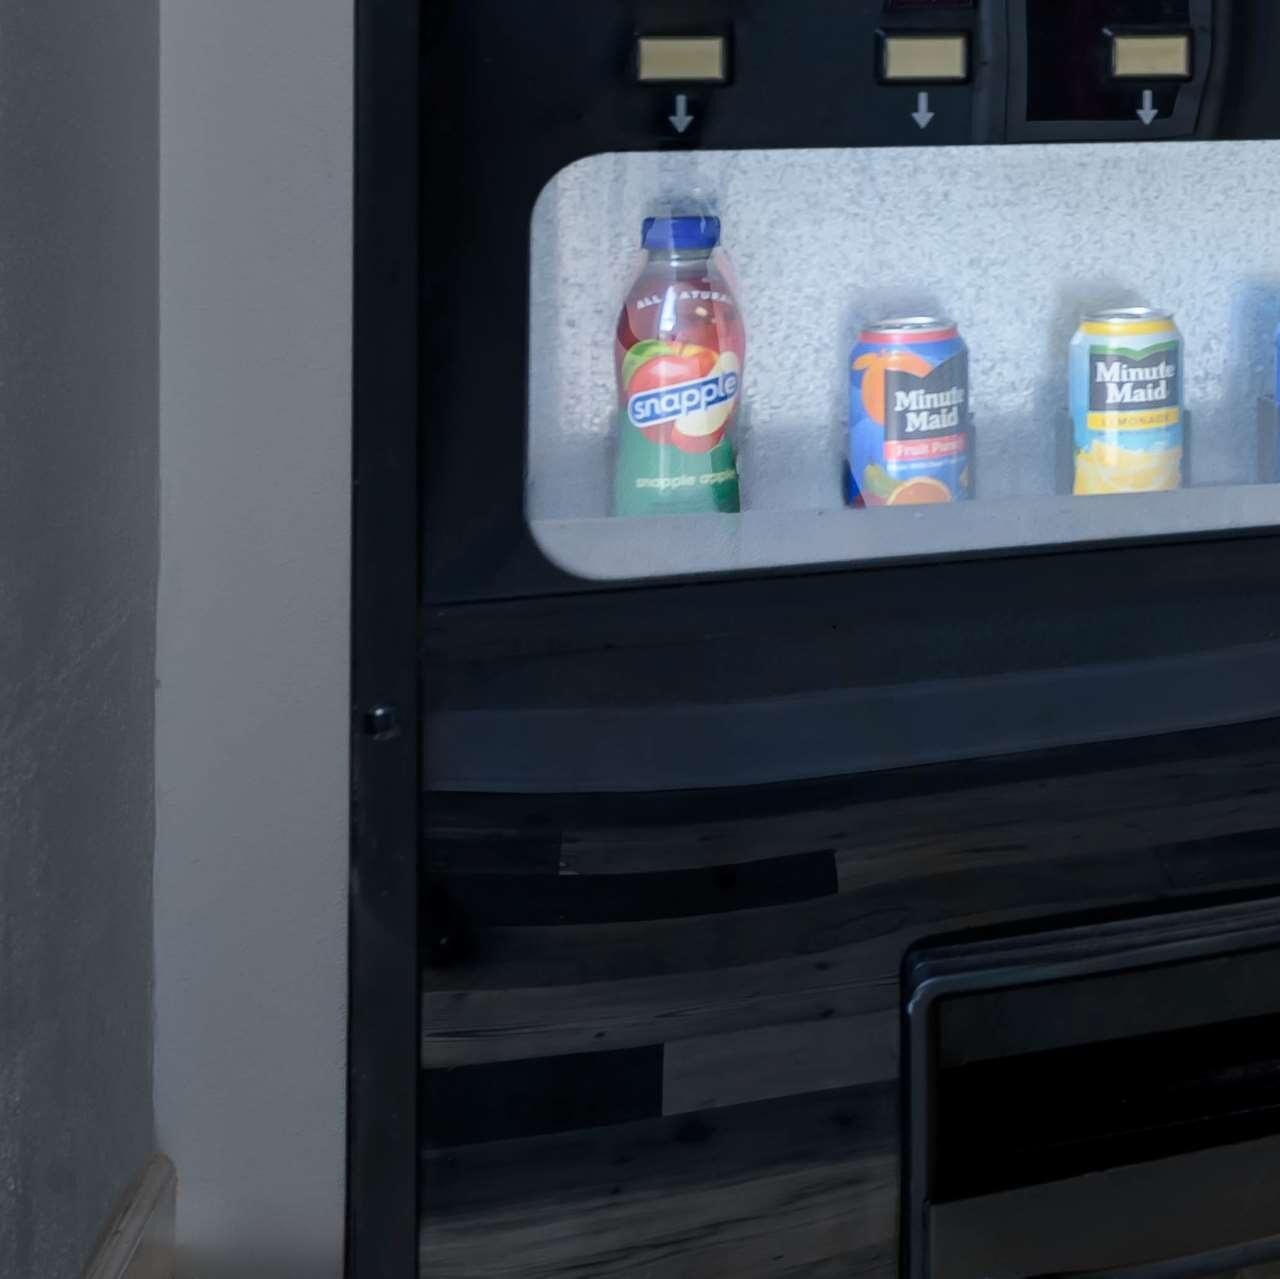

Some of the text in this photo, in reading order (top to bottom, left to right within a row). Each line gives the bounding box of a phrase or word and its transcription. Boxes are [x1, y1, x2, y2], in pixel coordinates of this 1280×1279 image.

[636, 293, 661, 309] ALL
[1095, 360, 1176, 383] Minute
[634, 370, 738, 420] snapple
[893, 385, 965, 412] Minute
[1105, 379, 1167, 404] Maid
[904, 406, 959, 433] Maid
[635, 474, 695, 491] snapple
